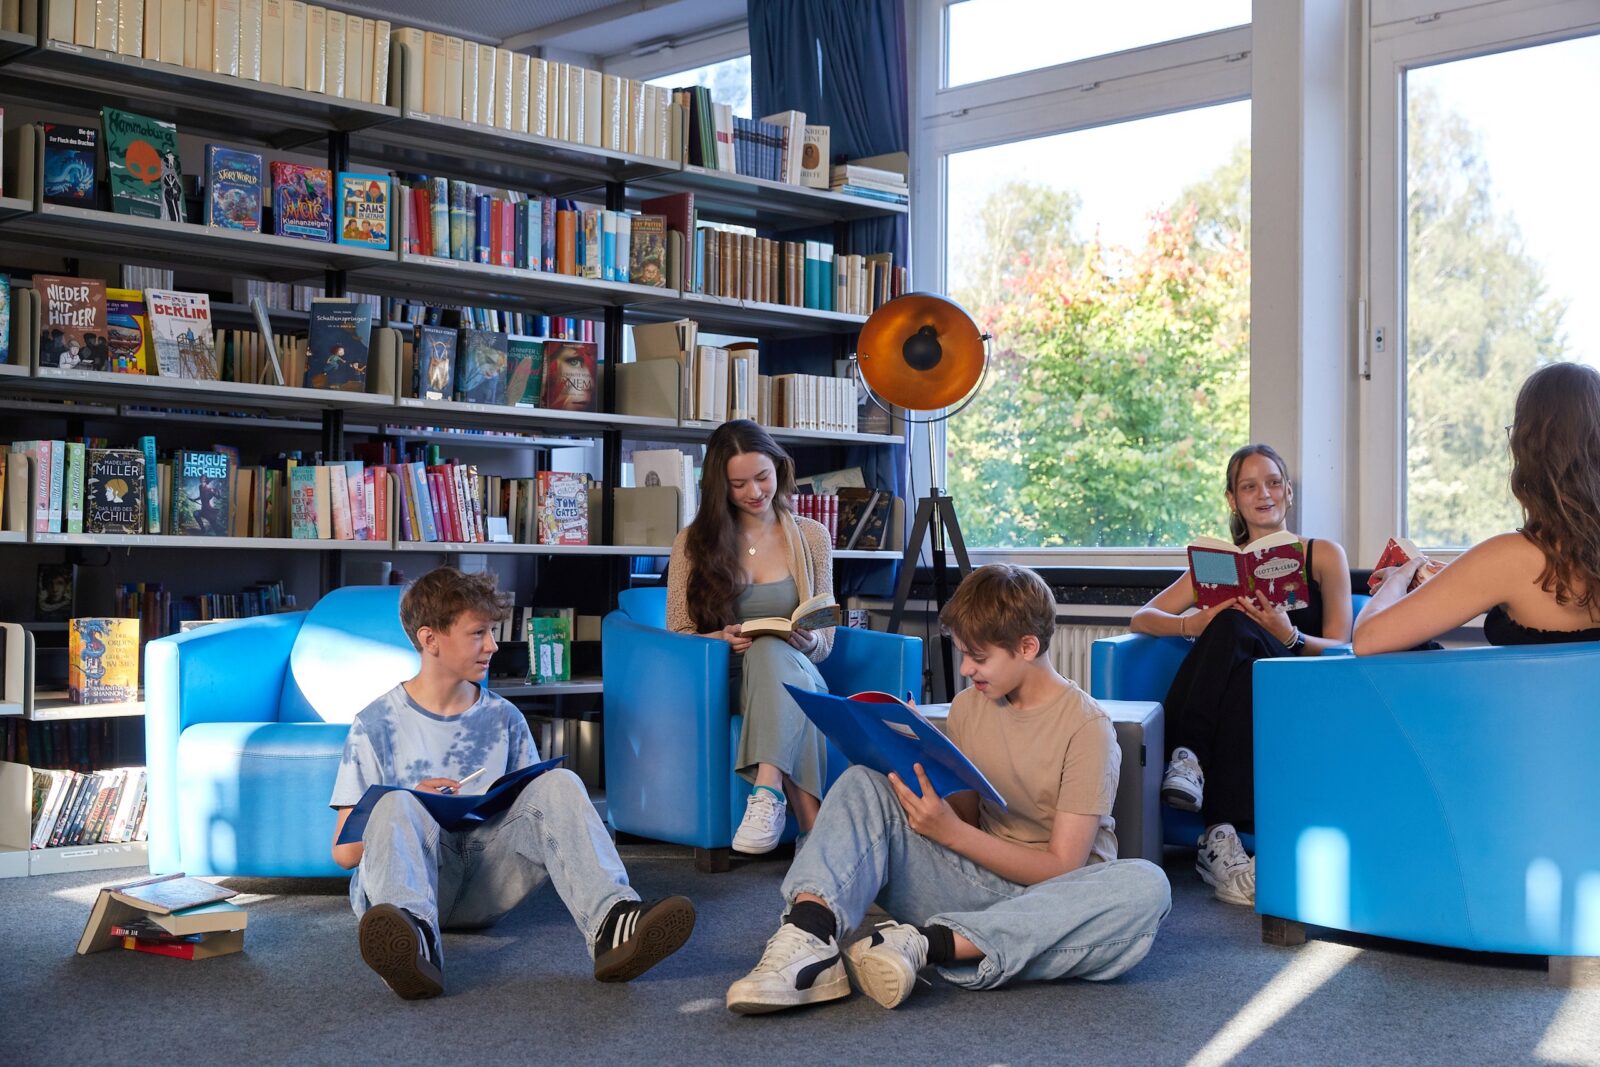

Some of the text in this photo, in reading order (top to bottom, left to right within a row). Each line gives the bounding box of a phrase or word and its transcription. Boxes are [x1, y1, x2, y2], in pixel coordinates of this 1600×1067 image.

[359, 204, 384, 213] SAMS
[282, 218, 328, 228] Kleinanzeigen
[46, 284, 90, 303] NIEDER
[48, 300, 72, 313] MIT
[154, 304, 208, 320] BERLIN
[48, 306, 96, 326] HITLER!
[316, 315, 367, 324] Schattenspringer
[184, 452, 227, 466] LEAGUE
[95, 465, 139, 476] MILLER
[184, 467, 226, 478] ARCHERS
[556, 498, 576, 508] TOM
[94, 510, 136, 522] ACHILL
[556, 508, 578, 517] GATES
